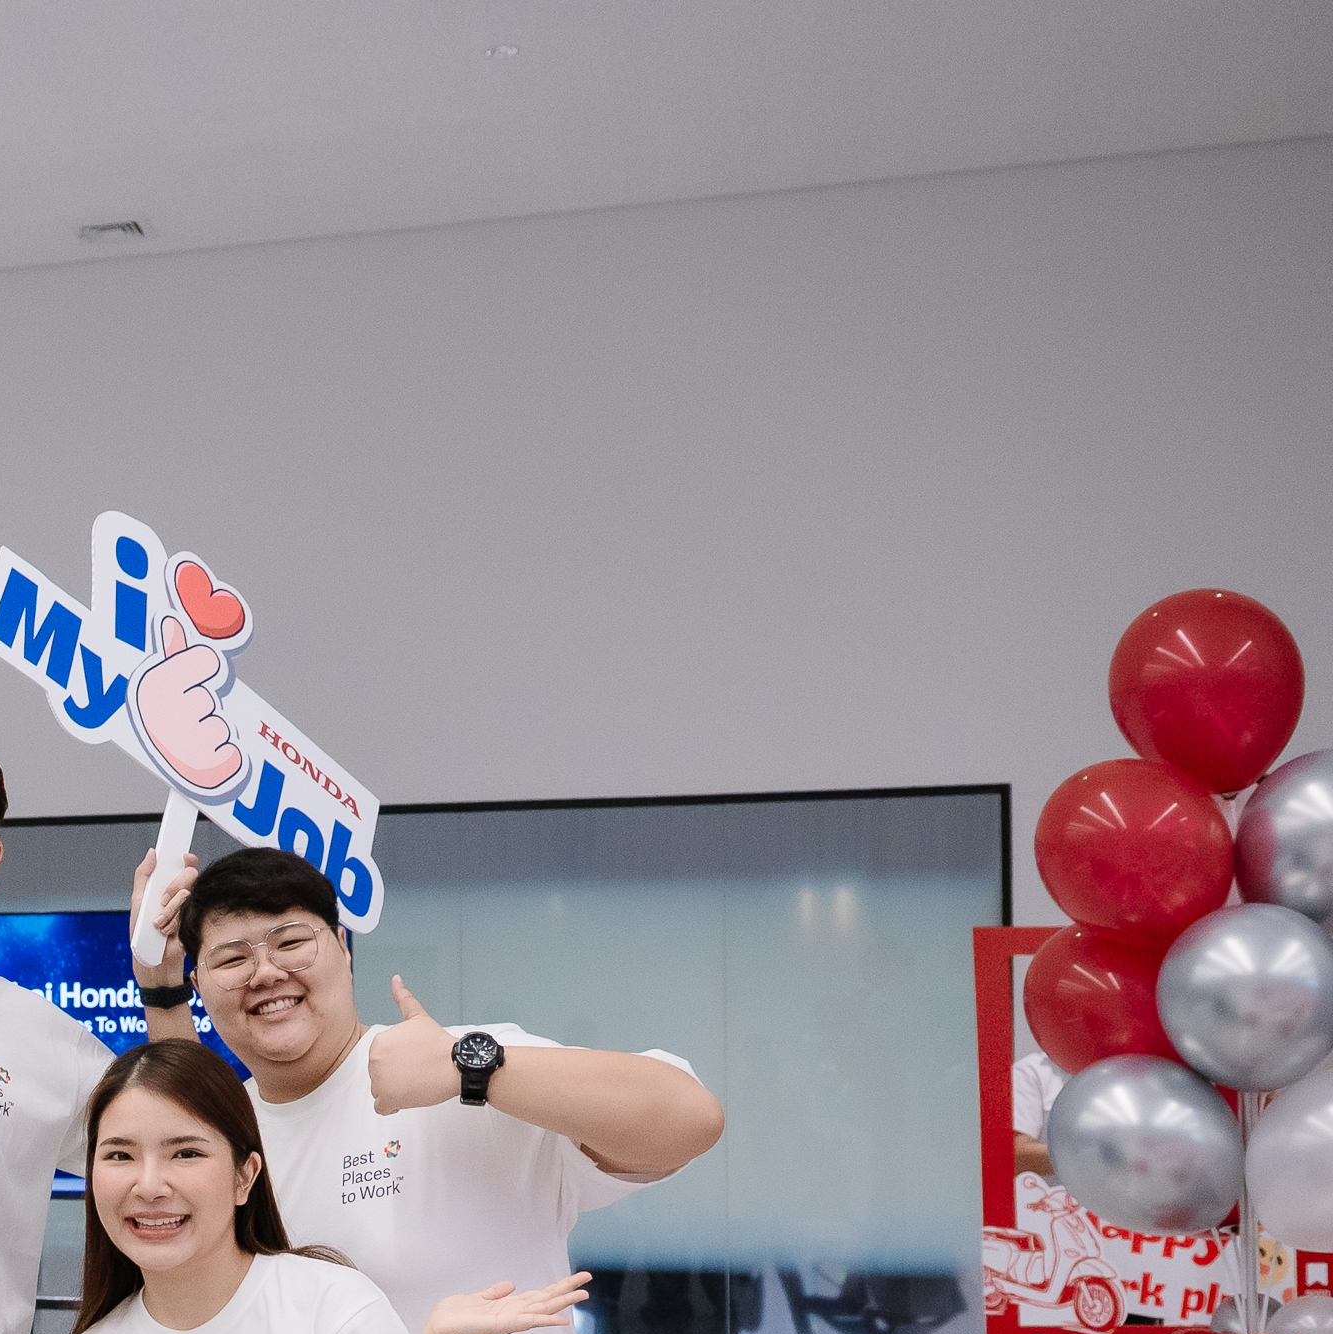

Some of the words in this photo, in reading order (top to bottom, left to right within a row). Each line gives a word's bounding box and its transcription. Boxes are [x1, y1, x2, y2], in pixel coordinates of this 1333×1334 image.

[115, 535, 149, 653] i
[257, 720, 362, 821] HONDA
[232, 759, 373, 917] Job
[94, 1016, 118, 1034] To
[119, 1016, 149, 1034] Wo
[191, 1015, 213, 1033] 26
[342, 1150, 375, 1170] Best
[342, 1167, 391, 1187] Places
[341, 1192, 356, 1205] to
[1086, 1211, 1232, 1266] appy
